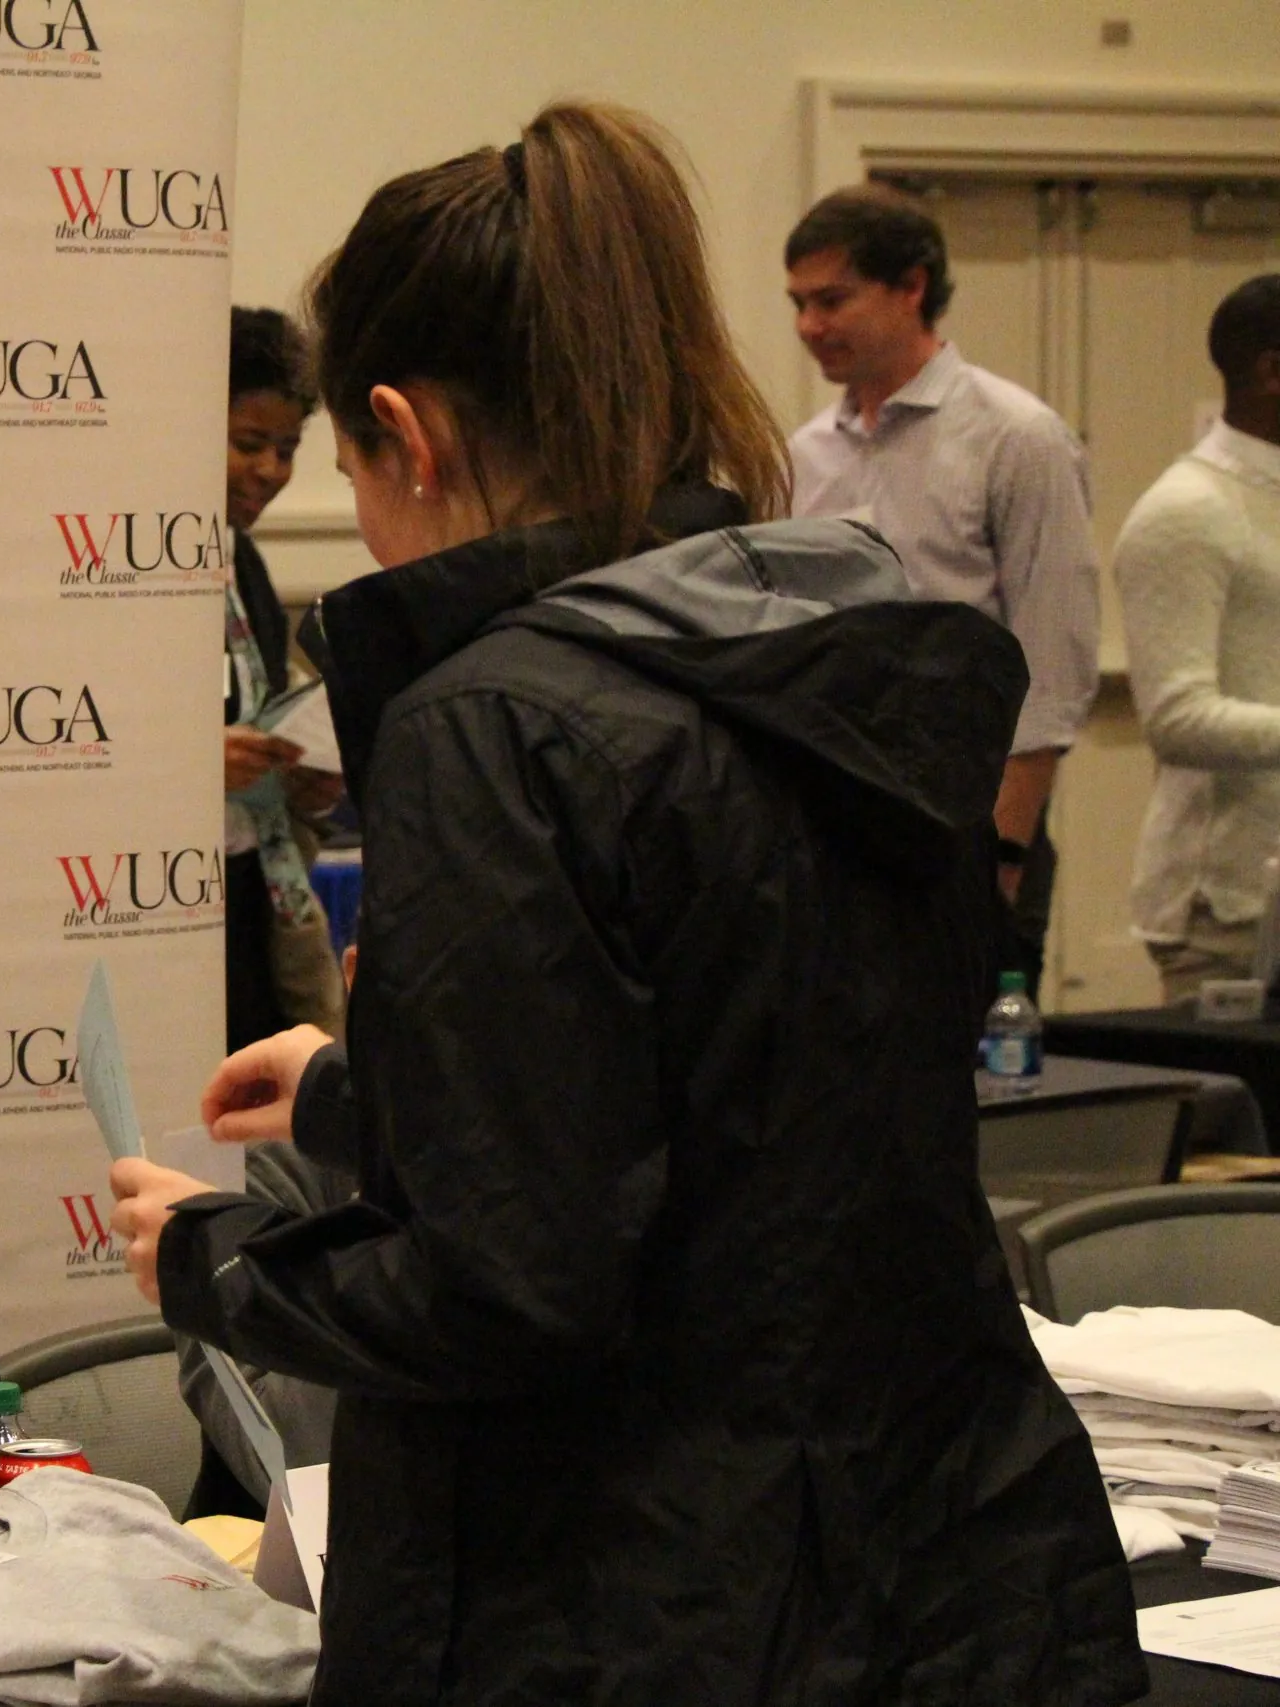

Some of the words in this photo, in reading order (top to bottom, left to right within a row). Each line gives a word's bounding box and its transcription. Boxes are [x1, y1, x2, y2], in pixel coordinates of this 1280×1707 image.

[47, 167, 228, 231] WUGA
[55, 220, 80, 239] the
[82, 213, 135, 240] Classic
[53, 512, 224, 571] WUGA
[60, 566, 84, 585] the
[86, 558, 139, 585] Classic
[56, 848, 225, 912] WUGA
[64, 908, 89, 927] the
[90, 899, 143, 926] Classic
[67, 1248, 91, 1265] the
